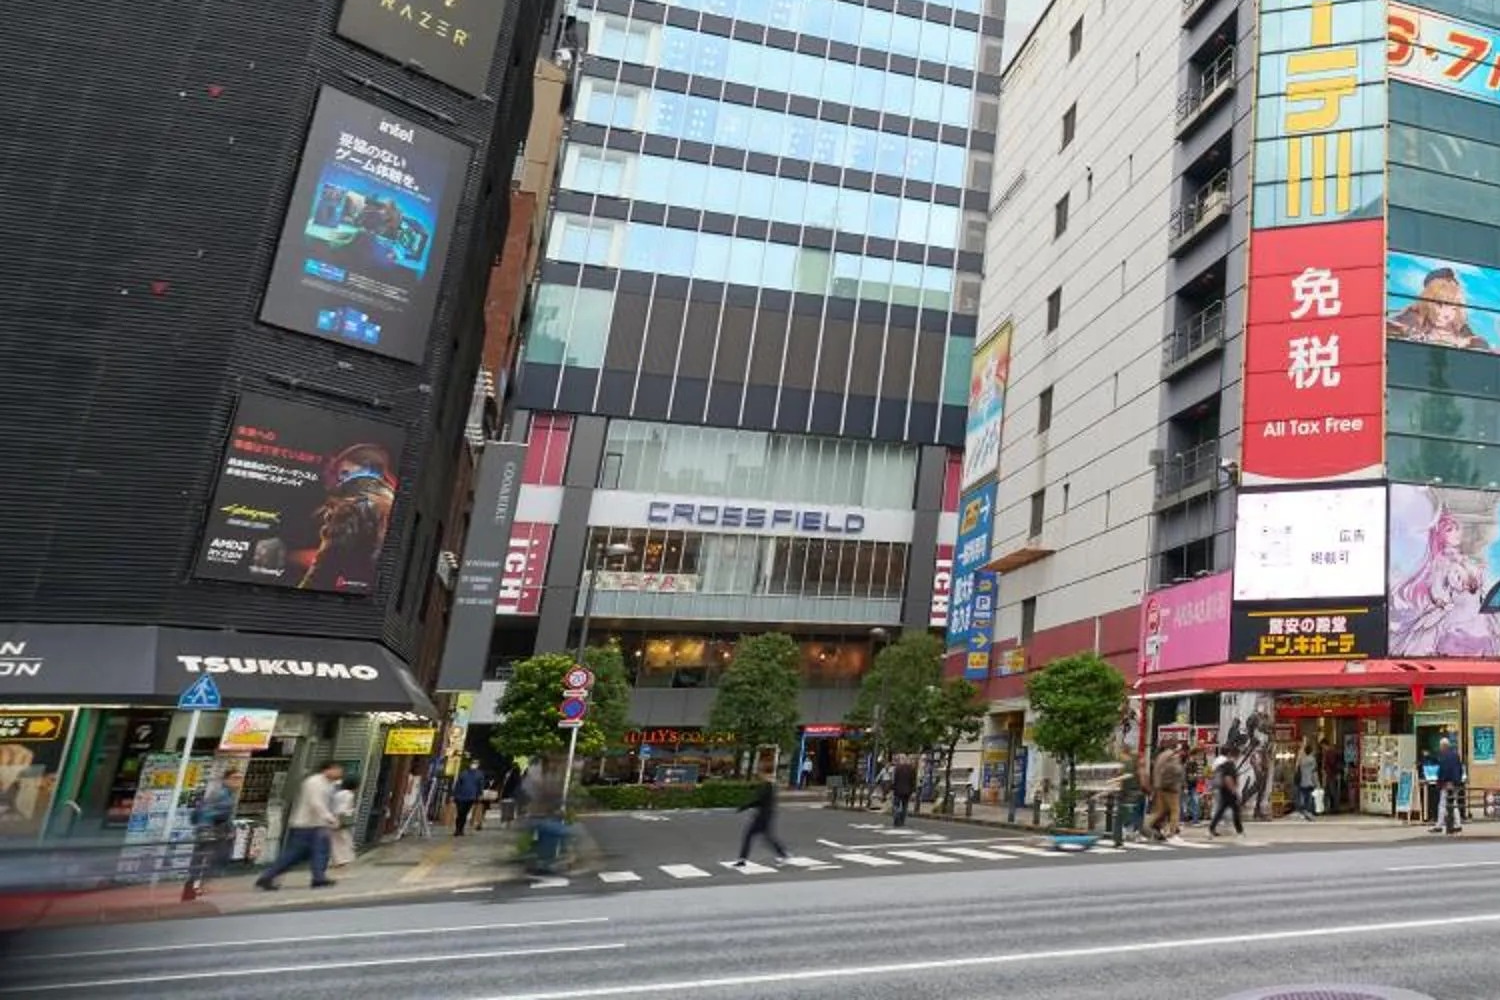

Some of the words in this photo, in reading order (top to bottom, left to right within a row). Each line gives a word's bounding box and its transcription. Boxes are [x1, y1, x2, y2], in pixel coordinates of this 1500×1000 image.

[379, 120, 414, 144] intel
[1287, 267, 1342, 389] 免税
[1263, 424, 1285, 437] All
[1291, 421, 1320, 434] Tax
[1325, 417, 1364, 432] Free
[1269, 616, 1347, 635] 驚安の殿堂
[177, 655, 379, 681] TSUKUMO
